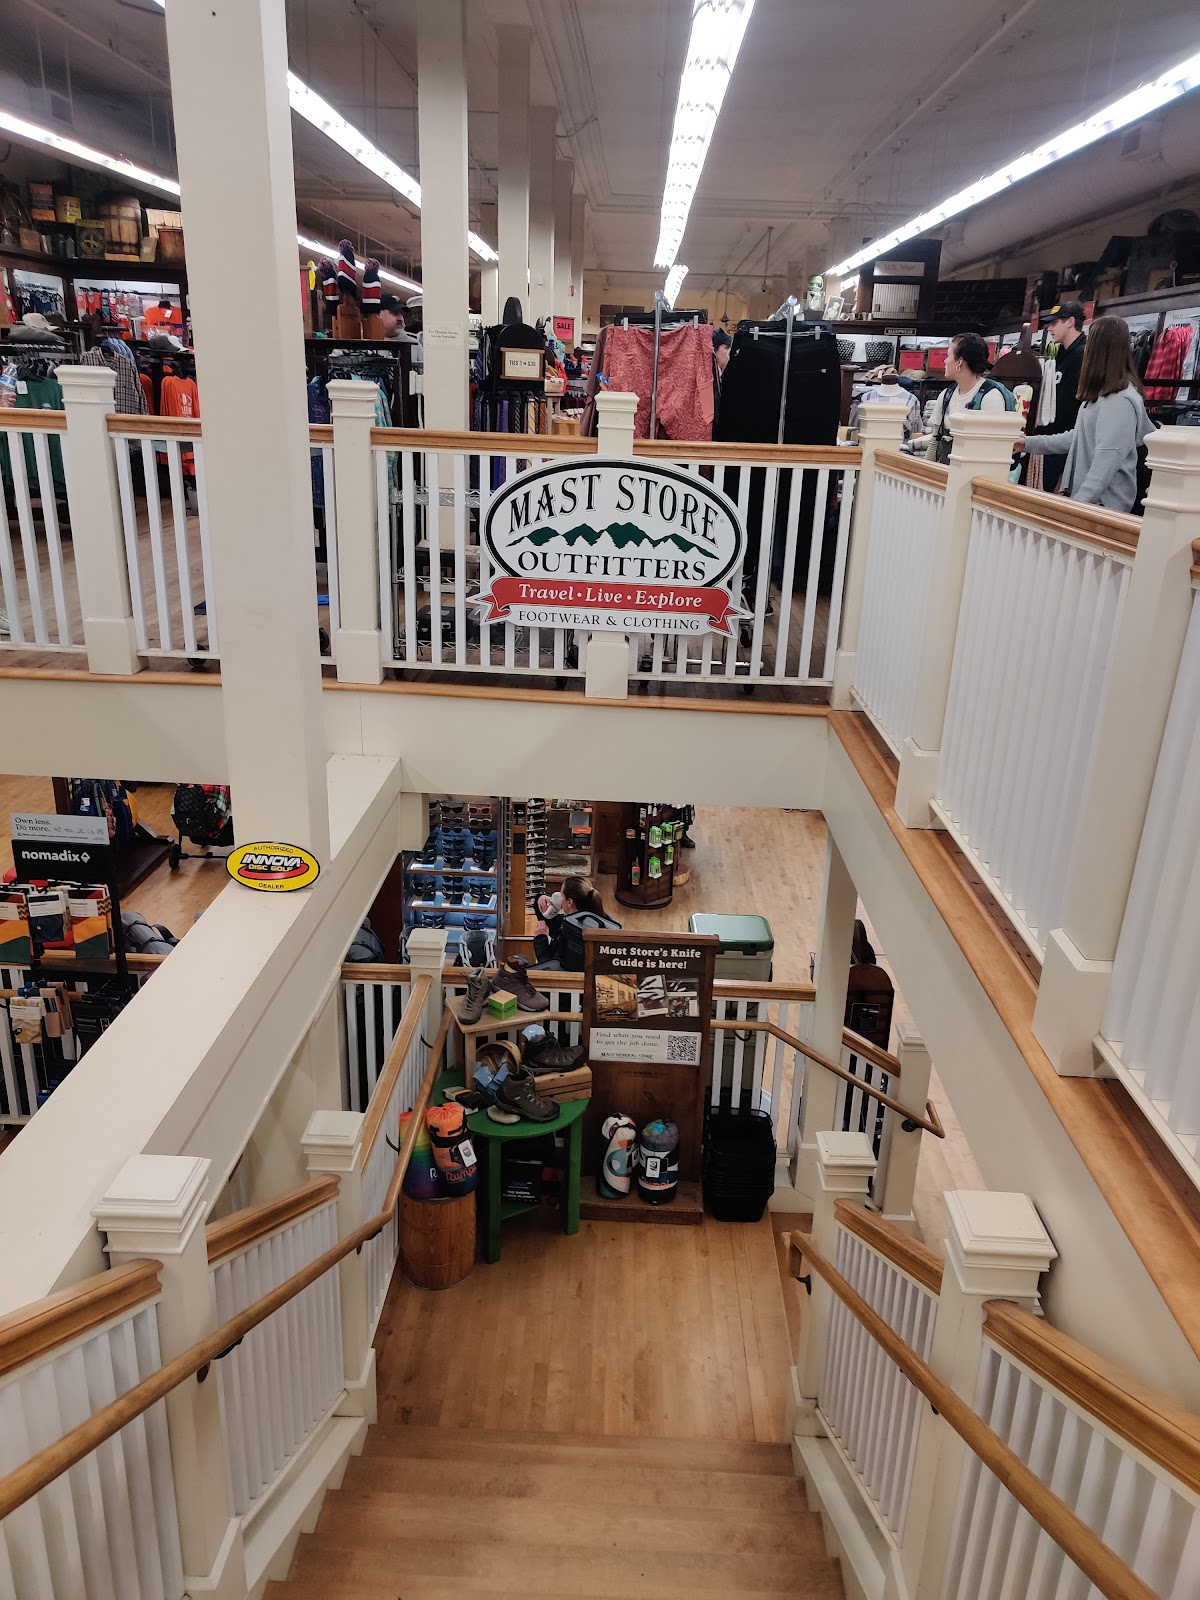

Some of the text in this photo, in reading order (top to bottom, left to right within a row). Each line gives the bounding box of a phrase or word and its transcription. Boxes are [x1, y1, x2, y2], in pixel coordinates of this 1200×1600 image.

[556, 322, 572, 330] SALE
[507, 473, 720, 549] MAST STORE
[517, 550, 707, 582] OUTFITTERS
[518, 583, 704, 612] Travel Live Explore
[518, 610, 701, 631] FOOTWEAR & CLOTHING
[14, 817, 53, 826] Own less.
[16, 823, 27, 831] Do
[253, 845, 294, 854] AUTHORIZED
[21, 850, 81, 863] nomadix
[241, 853, 301, 868] INNOVA
[258, 882, 285, 890] DEALER
[599, 945, 702, 958] Mast Store's Knife
[612, 958, 688, 969] Guide is here!
[631, 1034, 643, 1042] you
